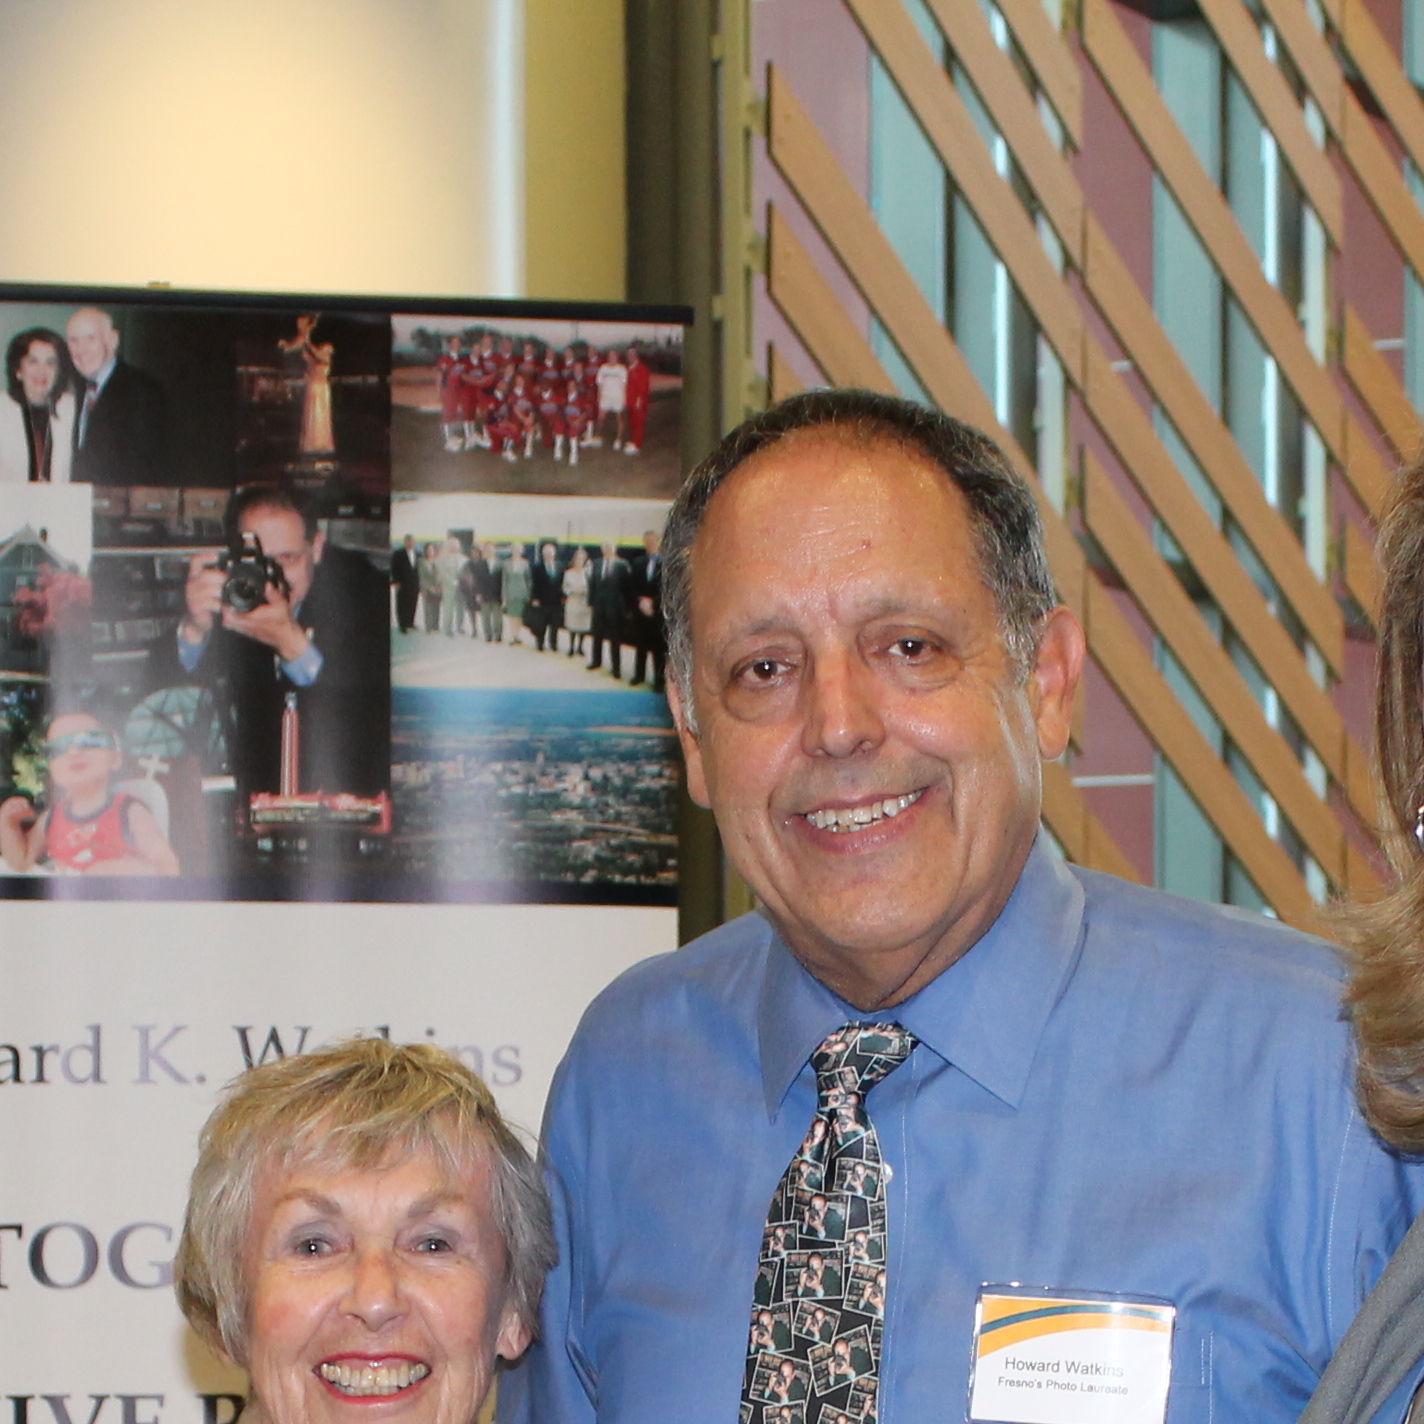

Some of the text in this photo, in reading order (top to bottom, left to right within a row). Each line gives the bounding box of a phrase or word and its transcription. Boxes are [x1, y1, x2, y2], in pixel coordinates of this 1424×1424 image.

[132, 1024, 208, 1086] K.
[1004, 1356, 1125, 1378] Howard Watkins
[997, 1376, 1129, 1395] Fresno's Photo Laureate
